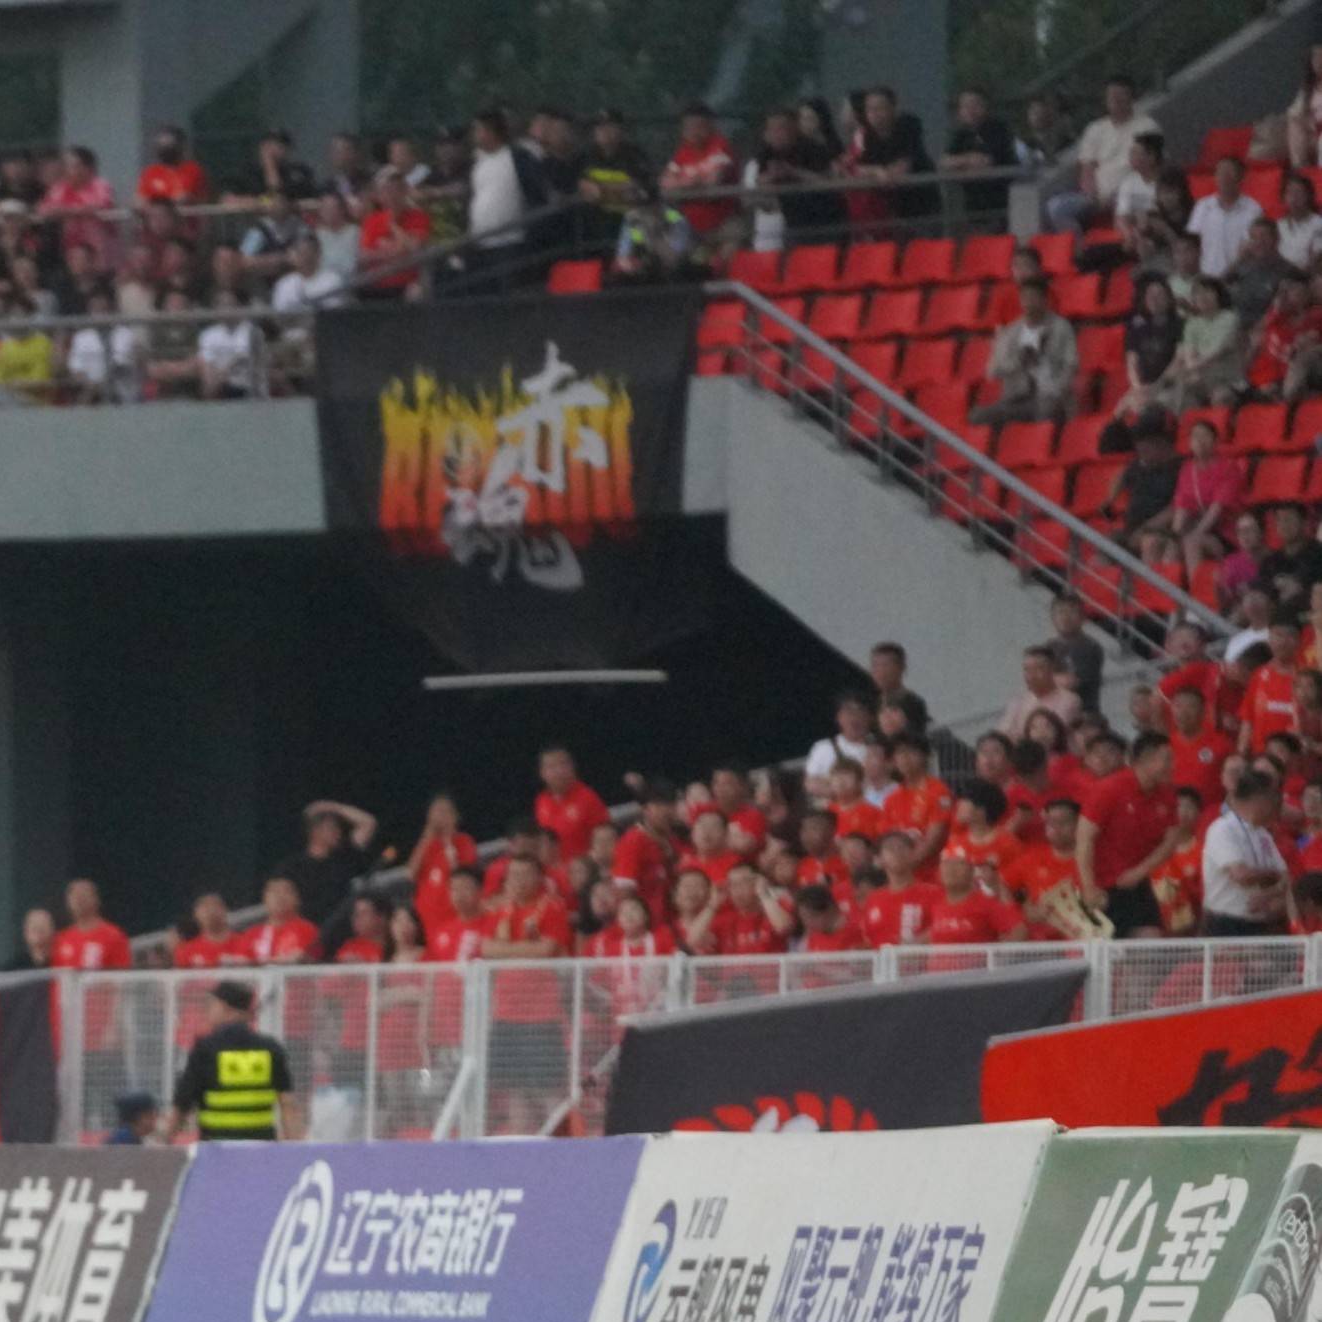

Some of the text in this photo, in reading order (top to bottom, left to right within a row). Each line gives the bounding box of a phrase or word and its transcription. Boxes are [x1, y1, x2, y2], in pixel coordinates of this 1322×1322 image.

[323, 1188, 524, 1275] 辽宁农商银行
